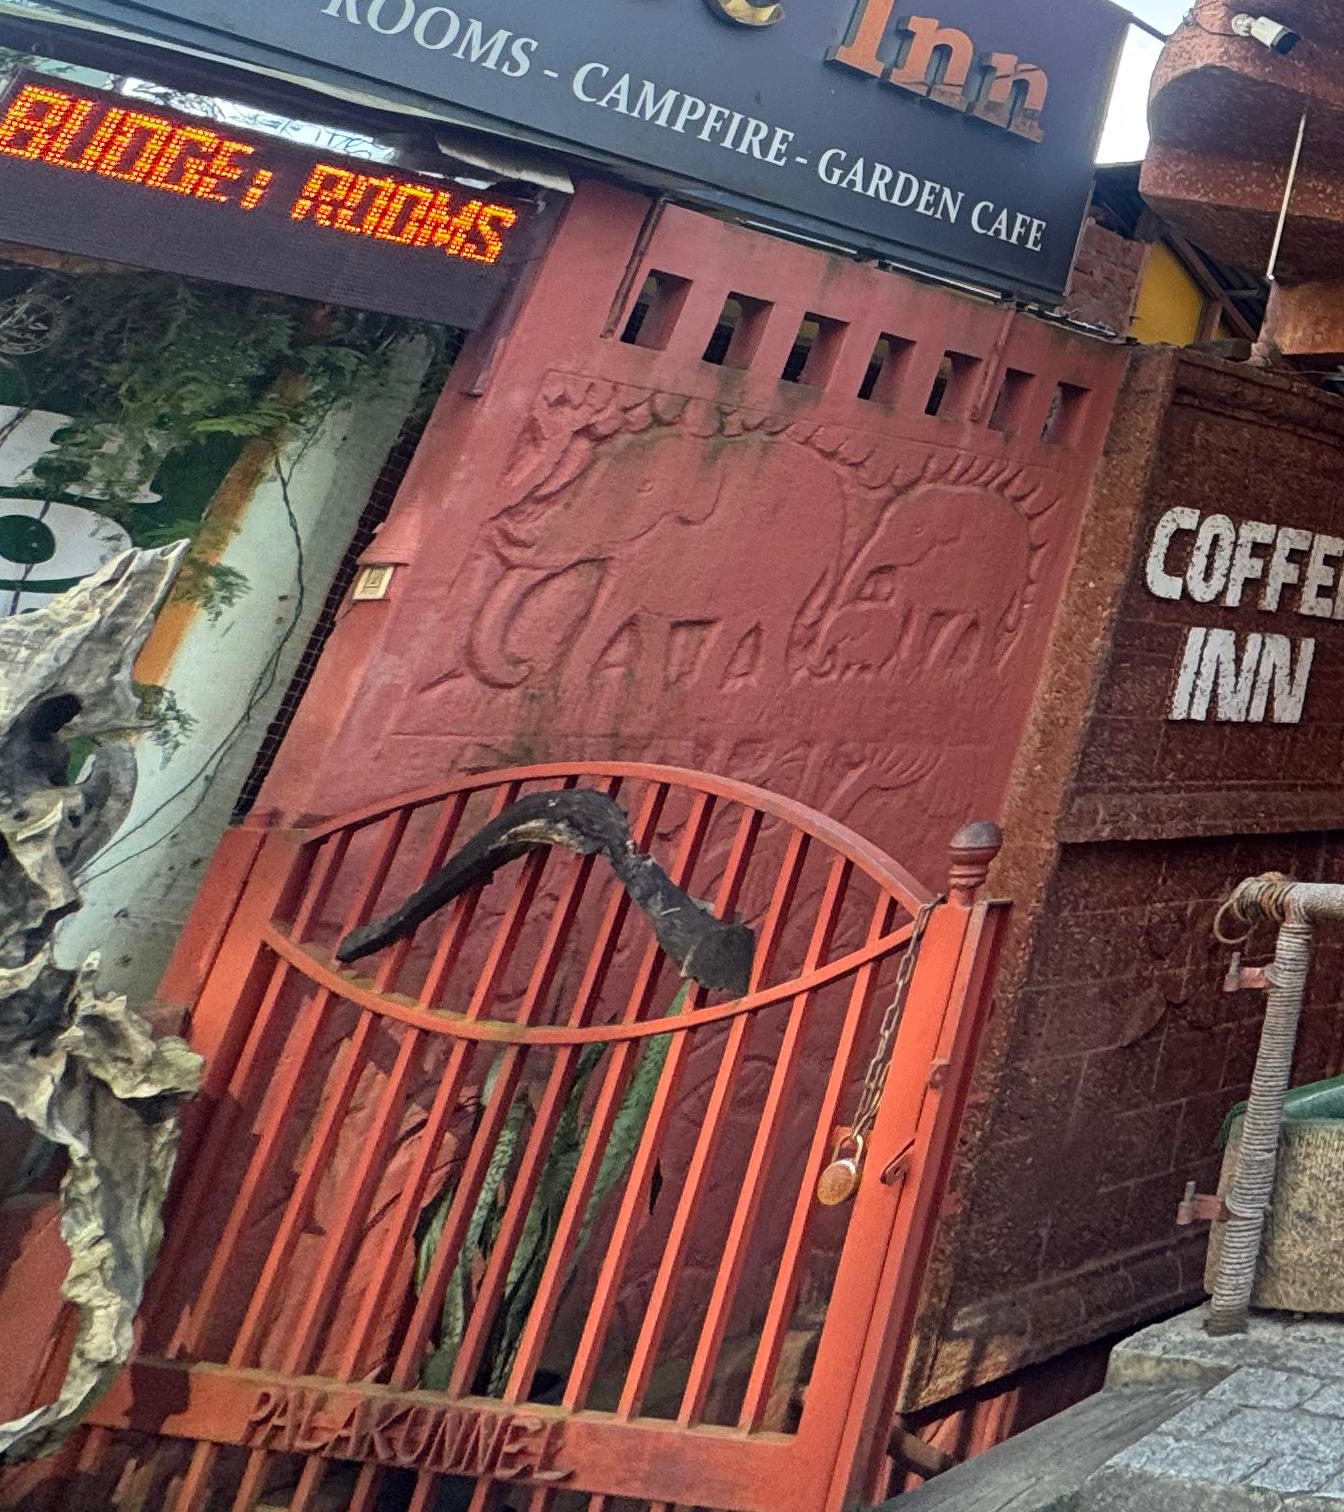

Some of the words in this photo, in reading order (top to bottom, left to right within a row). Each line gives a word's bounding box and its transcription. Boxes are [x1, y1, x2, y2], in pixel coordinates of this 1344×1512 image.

[572, 61, 795, 167] CAMPFIRE
[817, 147, 966, 224] GARDEN
[970, 199, 1048, 253] CAFE
[290, 163, 518, 265] ROOMS
[1167, 626, 1316, 724] INN
[239, 1390, 576, 1482] PALAKUNNEL
